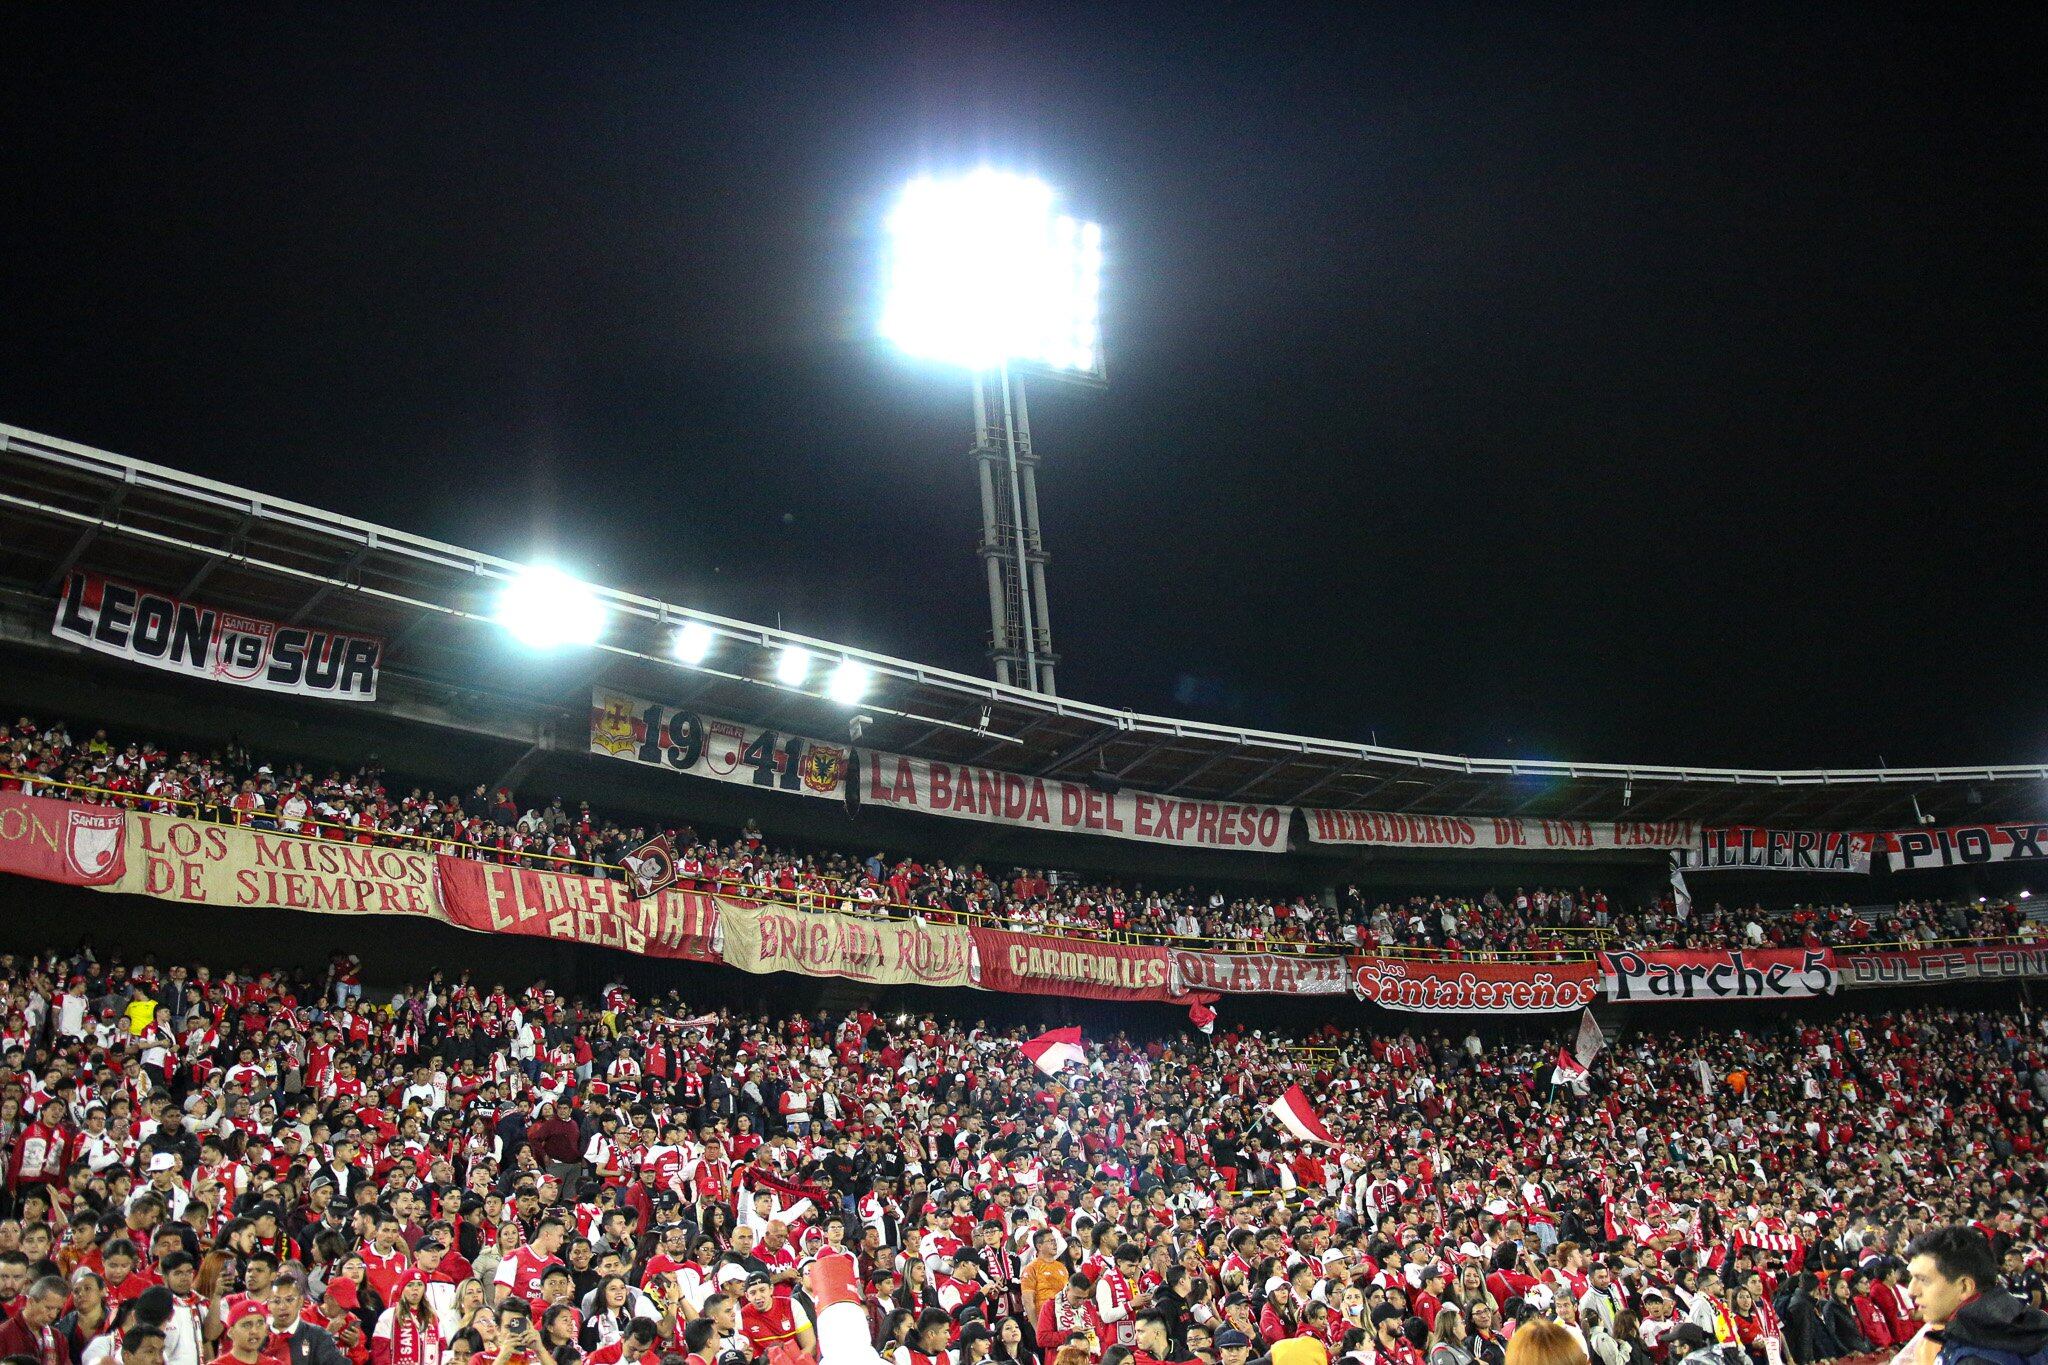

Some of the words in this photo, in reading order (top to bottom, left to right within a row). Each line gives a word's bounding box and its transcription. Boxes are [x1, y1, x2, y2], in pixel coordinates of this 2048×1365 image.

[60, 572, 217, 670] LEON
[223, 632, 263, 669] 19
[267, 627, 382, 693] SUR
[223, 616, 253, 634] SANTA
[258, 624, 271, 636] FE
[638, 704, 704, 770] 19
[741, 729, 805, 790] 41
[71, 814, 105, 828] SANTA
[870, 752, 917, 806] LA
[930, 761, 1050, 824] BANDA
[1061, 782, 1123, 833] DEL
[1135, 793, 1280, 848] EXPRESO
[137, 816, 228, 862] LOS
[1315, 808, 1477, 847] HEREDEROS
[1492, 816, 1528, 846] DE
[1541, 817, 1594, 847] UNA
[1900, 828, 1992, 868] PIO
[146, 857, 207, 903] DE
[253, 834, 428, 886] MISMOS
[237, 869, 430, 915] SIEMPRE
[549, 910, 646, 954] ROJO
[757, 915, 885, 973] BRIGADA
[894, 926, 965, 978] ROJA
[1009, 944, 1167, 989] CARDENALES
[1177, 952, 1298, 992] OLAYA
[1356, 965, 1598, 1010] Santafereños
[1605, 951, 1795, 999] Parche
[1800, 949, 1833, 997] 5
[1849, 952, 1967, 983] DULCE
[1974, 949, 2048, 978] CON
